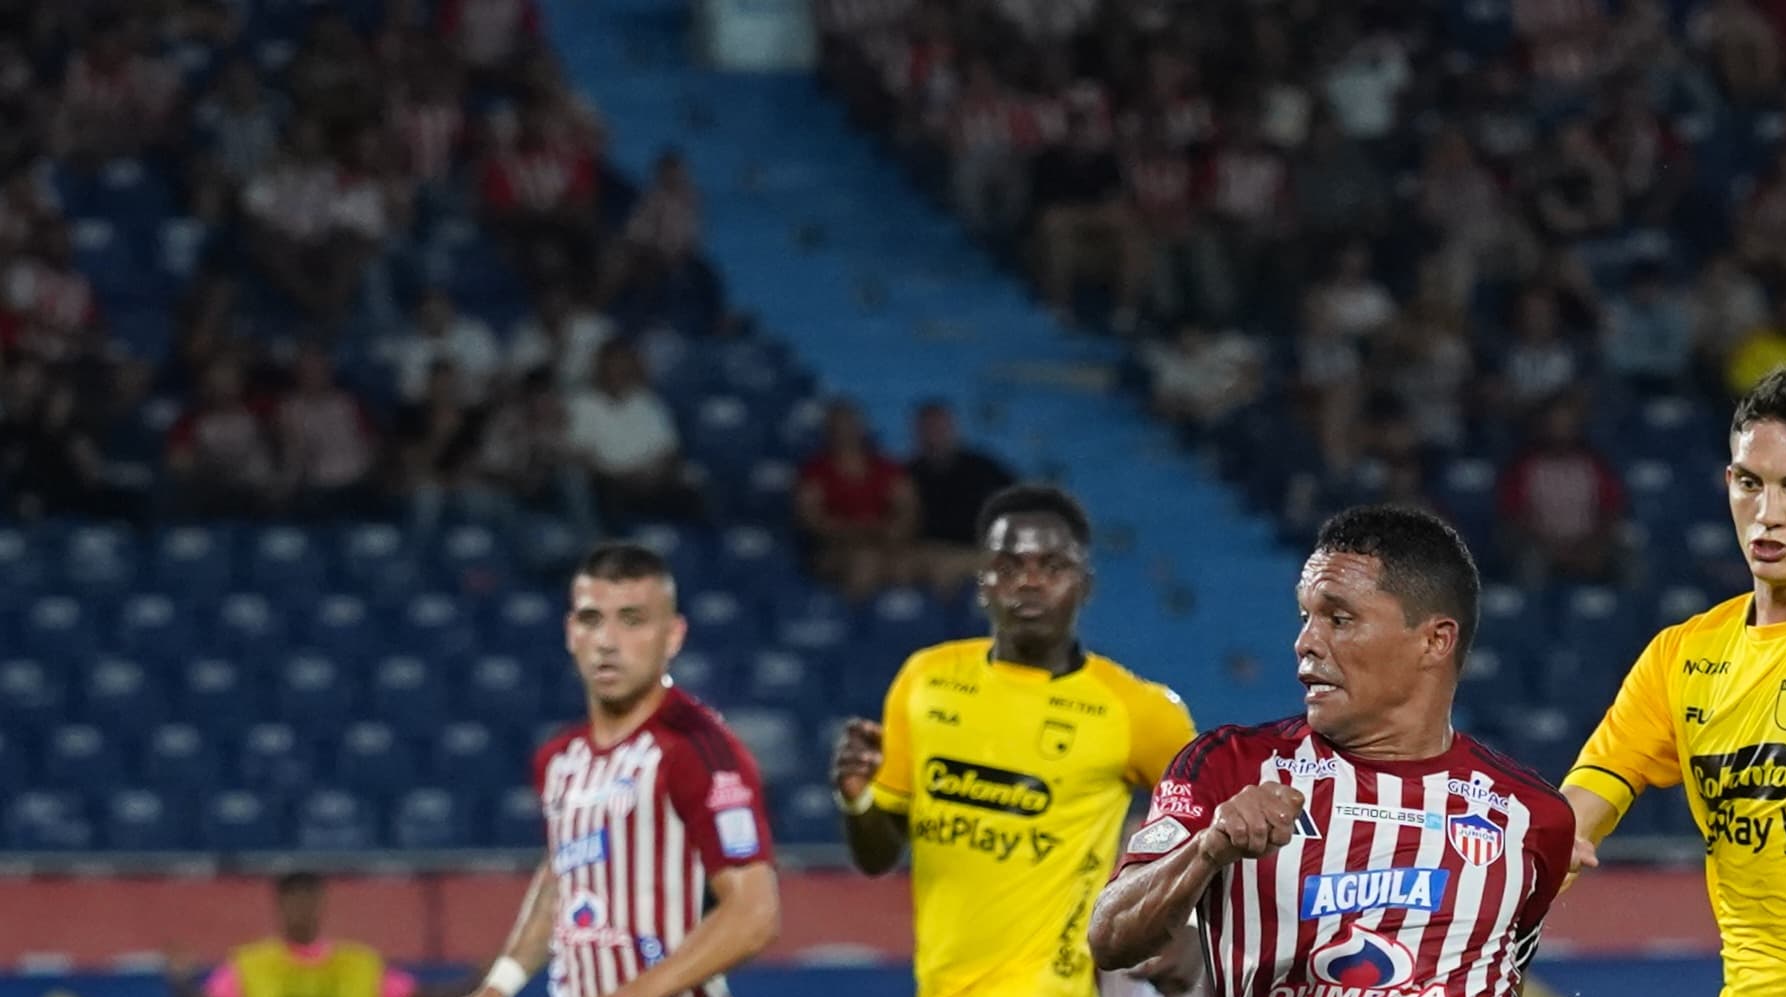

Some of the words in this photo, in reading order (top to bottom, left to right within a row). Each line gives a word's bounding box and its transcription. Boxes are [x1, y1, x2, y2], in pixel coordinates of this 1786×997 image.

[1160, 779, 1192, 797] RON
[1335, 805, 1425, 825] TECNOGLASS
[1458, 827, 1496, 842] JUNIOR
[1310, 870, 1433, 916] AGUILA
